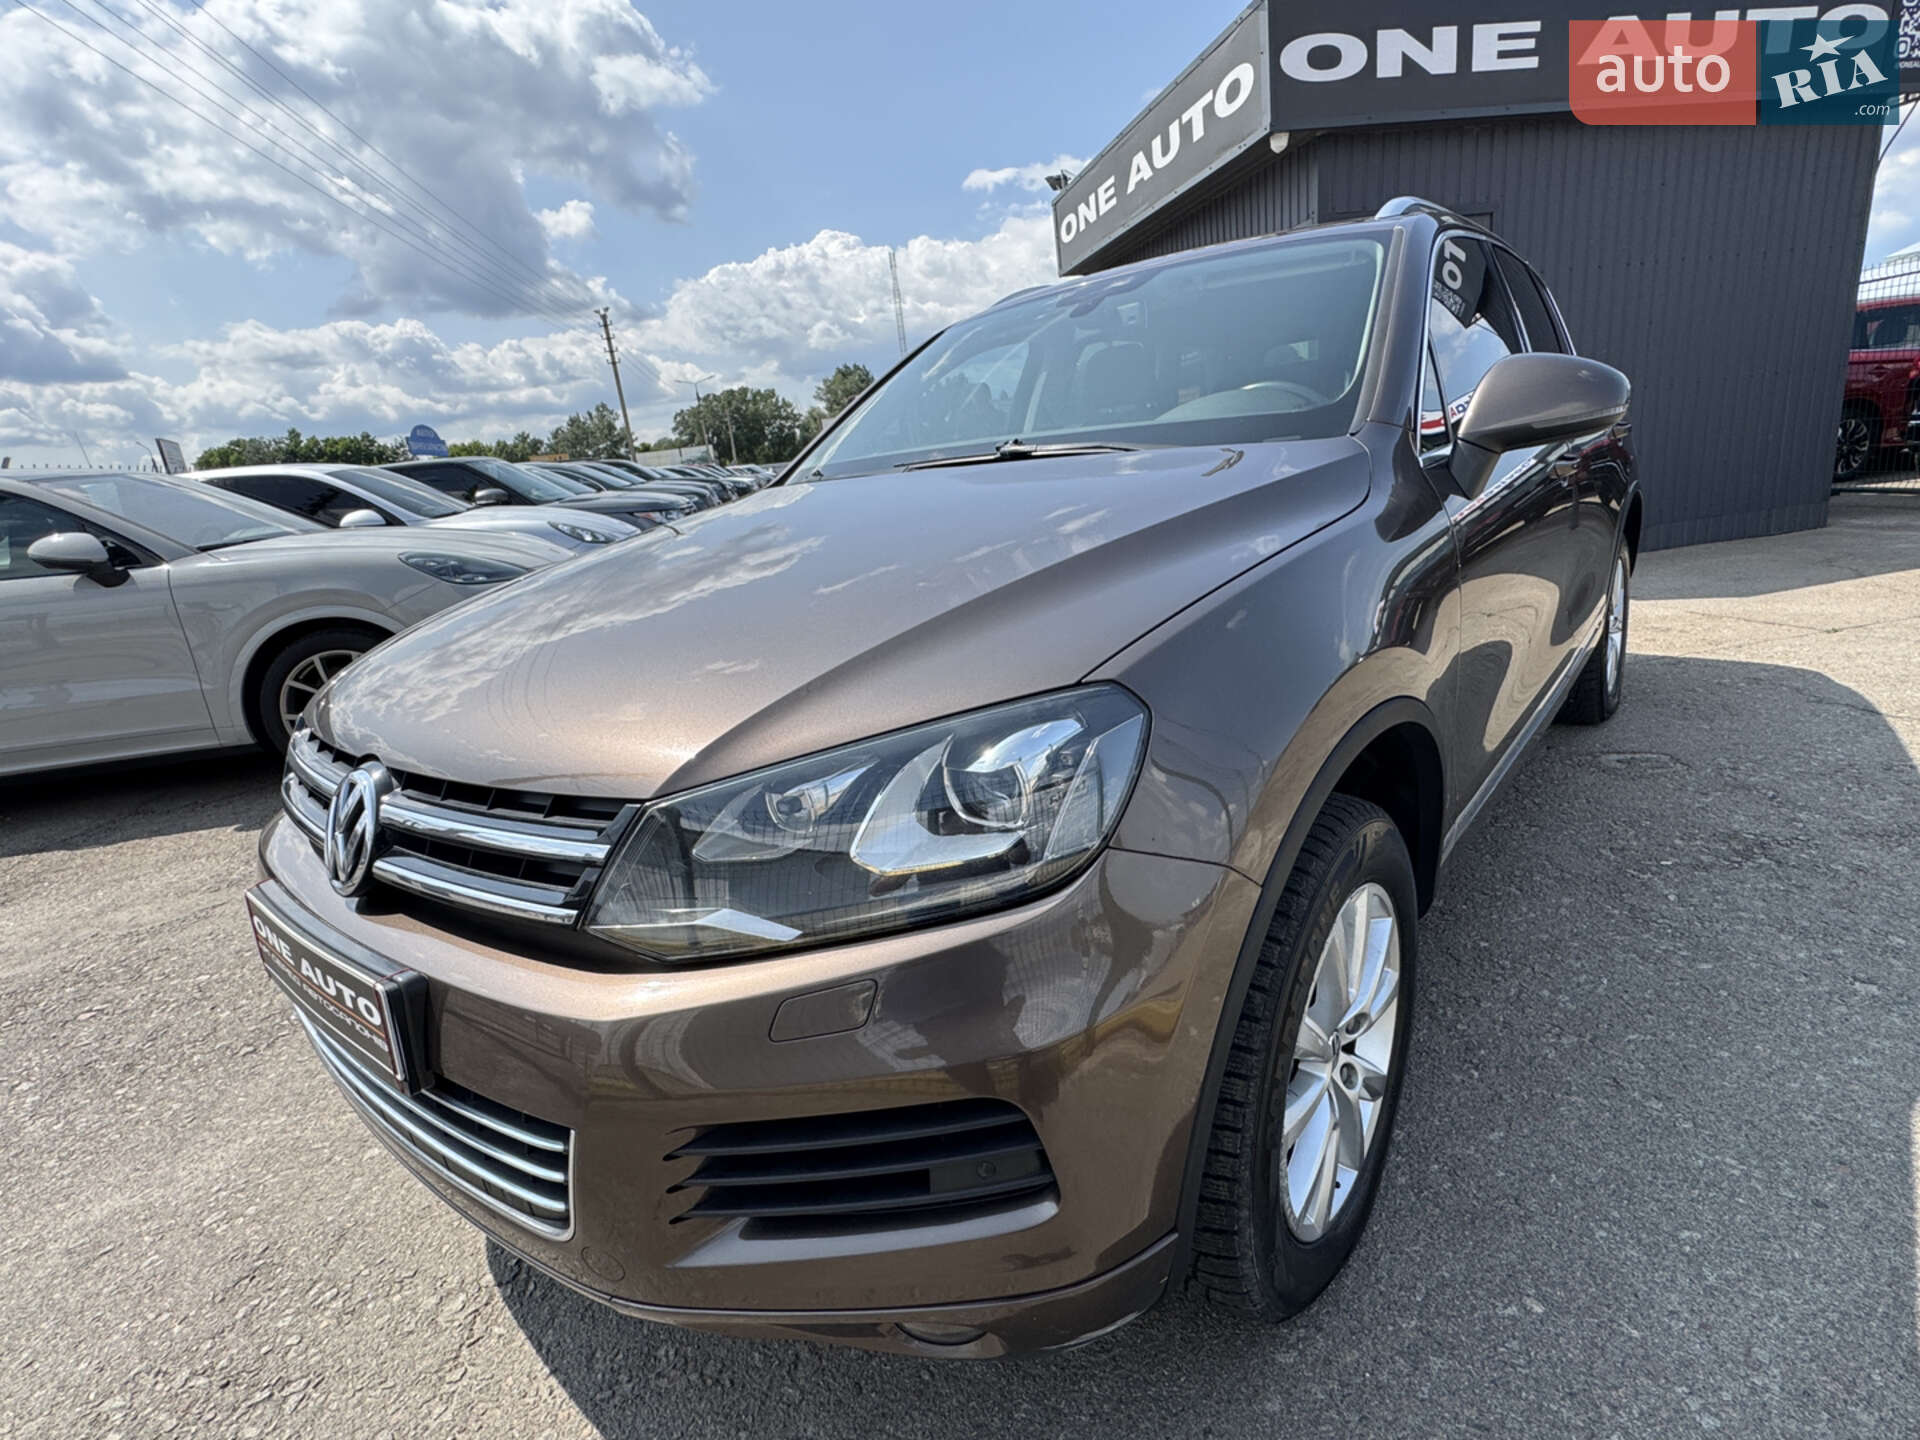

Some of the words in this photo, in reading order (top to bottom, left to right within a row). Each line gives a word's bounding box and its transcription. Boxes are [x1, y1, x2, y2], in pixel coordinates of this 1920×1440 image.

[1279, 20, 1542, 82] ONE
[1576, 4, 1890, 66] AUTO
[1060, 176, 1118, 244] ONE
[1126, 62, 1255, 195] AUTO
[252, 915, 296, 966] ONE
[300, 957, 382, 1027] AUTO
